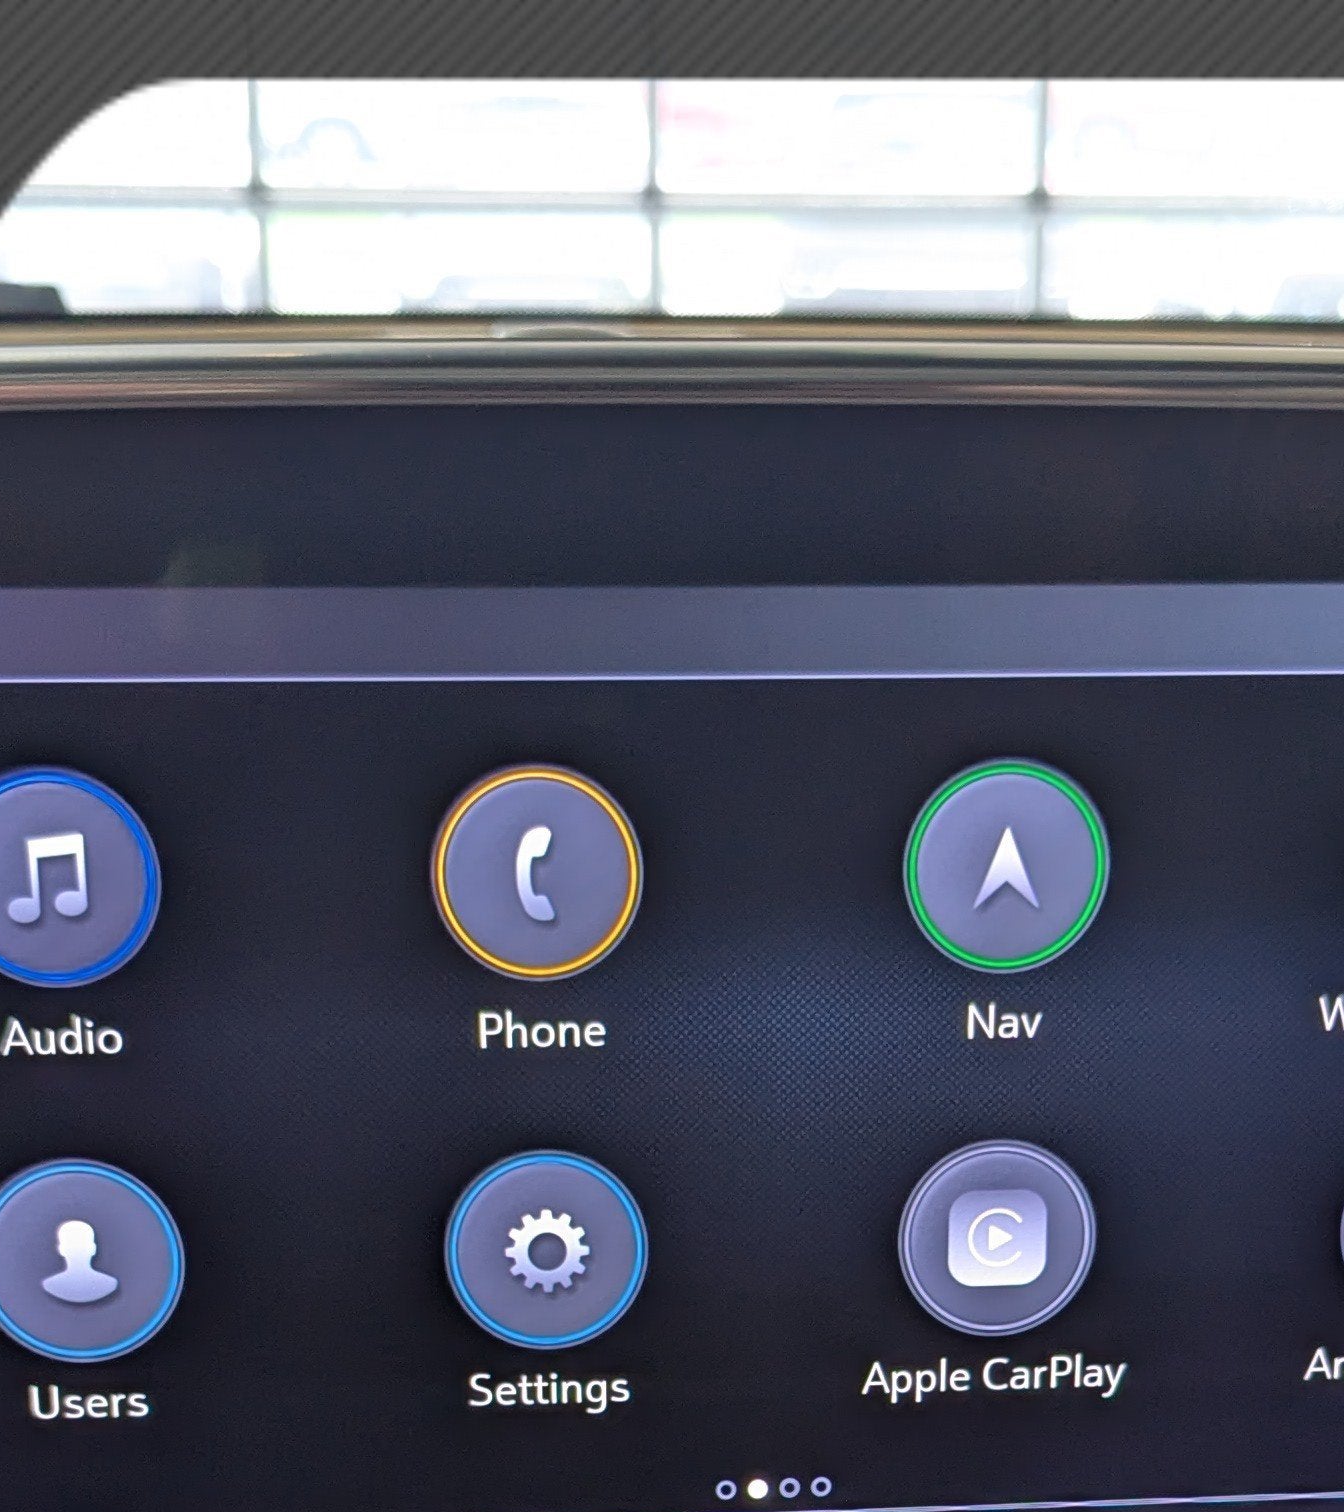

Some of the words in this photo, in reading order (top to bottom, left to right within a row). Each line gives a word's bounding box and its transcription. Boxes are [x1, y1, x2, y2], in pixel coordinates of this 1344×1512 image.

[0, 1015, 122, 1056] Audio
[479, 1009, 606, 1049] Phone
[967, 1002, 1043, 1039] Nav
[470, 1373, 630, 1414] Settings
[862, 1358, 970, 1403] Apple
[983, 1353, 1126, 1398] CarPlay
[30, 1385, 149, 1419] Users
